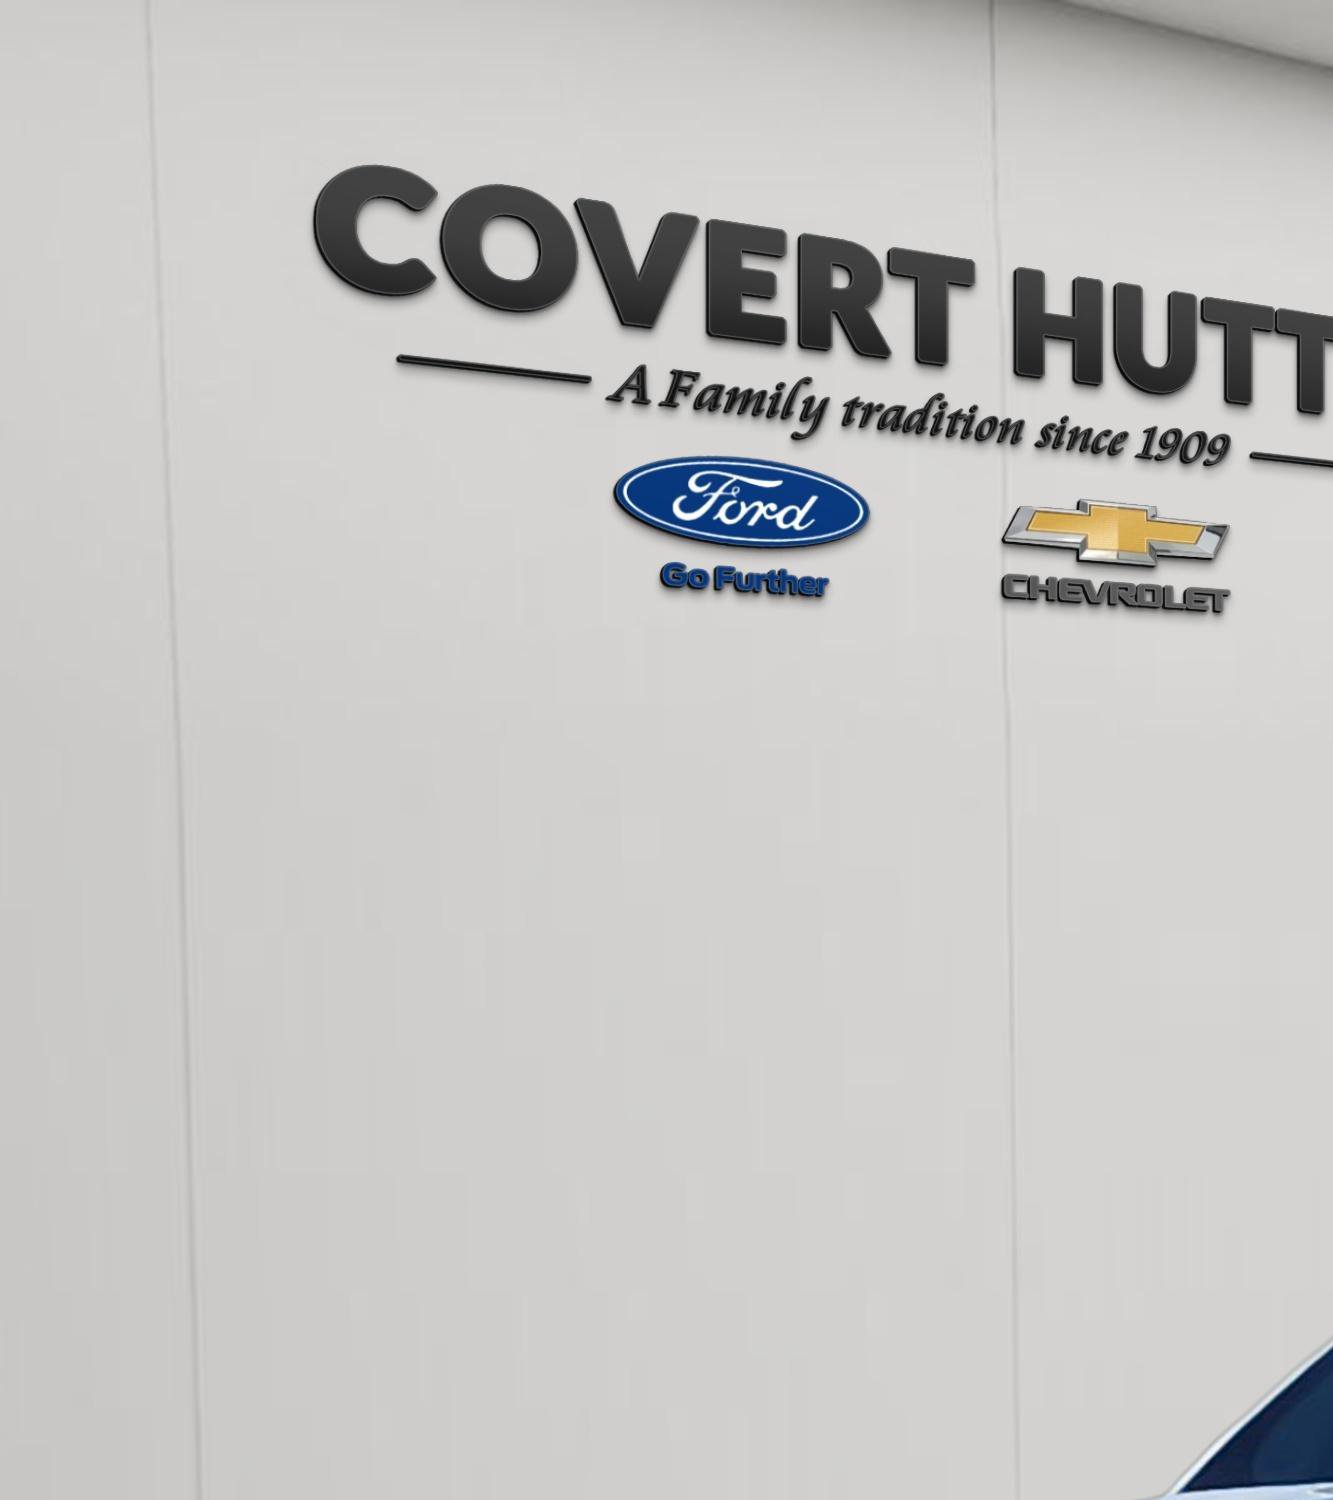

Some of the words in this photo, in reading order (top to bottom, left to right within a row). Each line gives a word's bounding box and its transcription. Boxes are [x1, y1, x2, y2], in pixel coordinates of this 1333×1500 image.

[312, 164, 976, 367] COVERT
[605, 363, 651, 405] A
[658, 367, 831, 440] Family
[841, 391, 1024, 447] tradition
[1034, 414, 1129, 456] since
[1135, 425, 1231, 467] 1909
[672, 470, 818, 531] Ford
[660, 562, 710, 591] Go
[713, 565, 829, 597] Further
[1001, 573, 1232, 613] CHEVROLET
